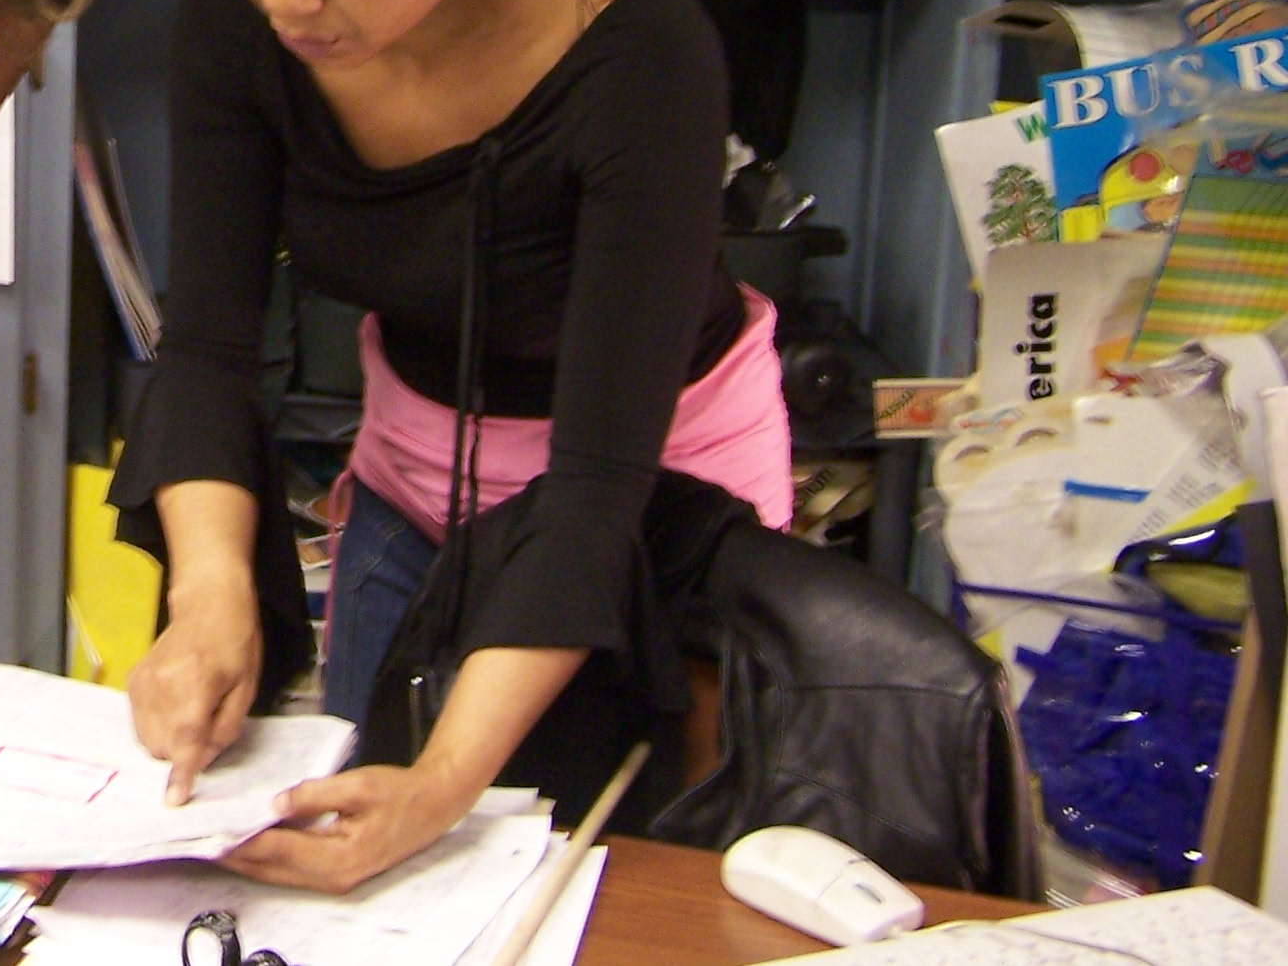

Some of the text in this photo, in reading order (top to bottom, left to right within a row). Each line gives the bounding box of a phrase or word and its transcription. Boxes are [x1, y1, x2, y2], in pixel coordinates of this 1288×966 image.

[1046, 37, 1288, 130] BUS R
[1015, 293, 1055, 400] erica
